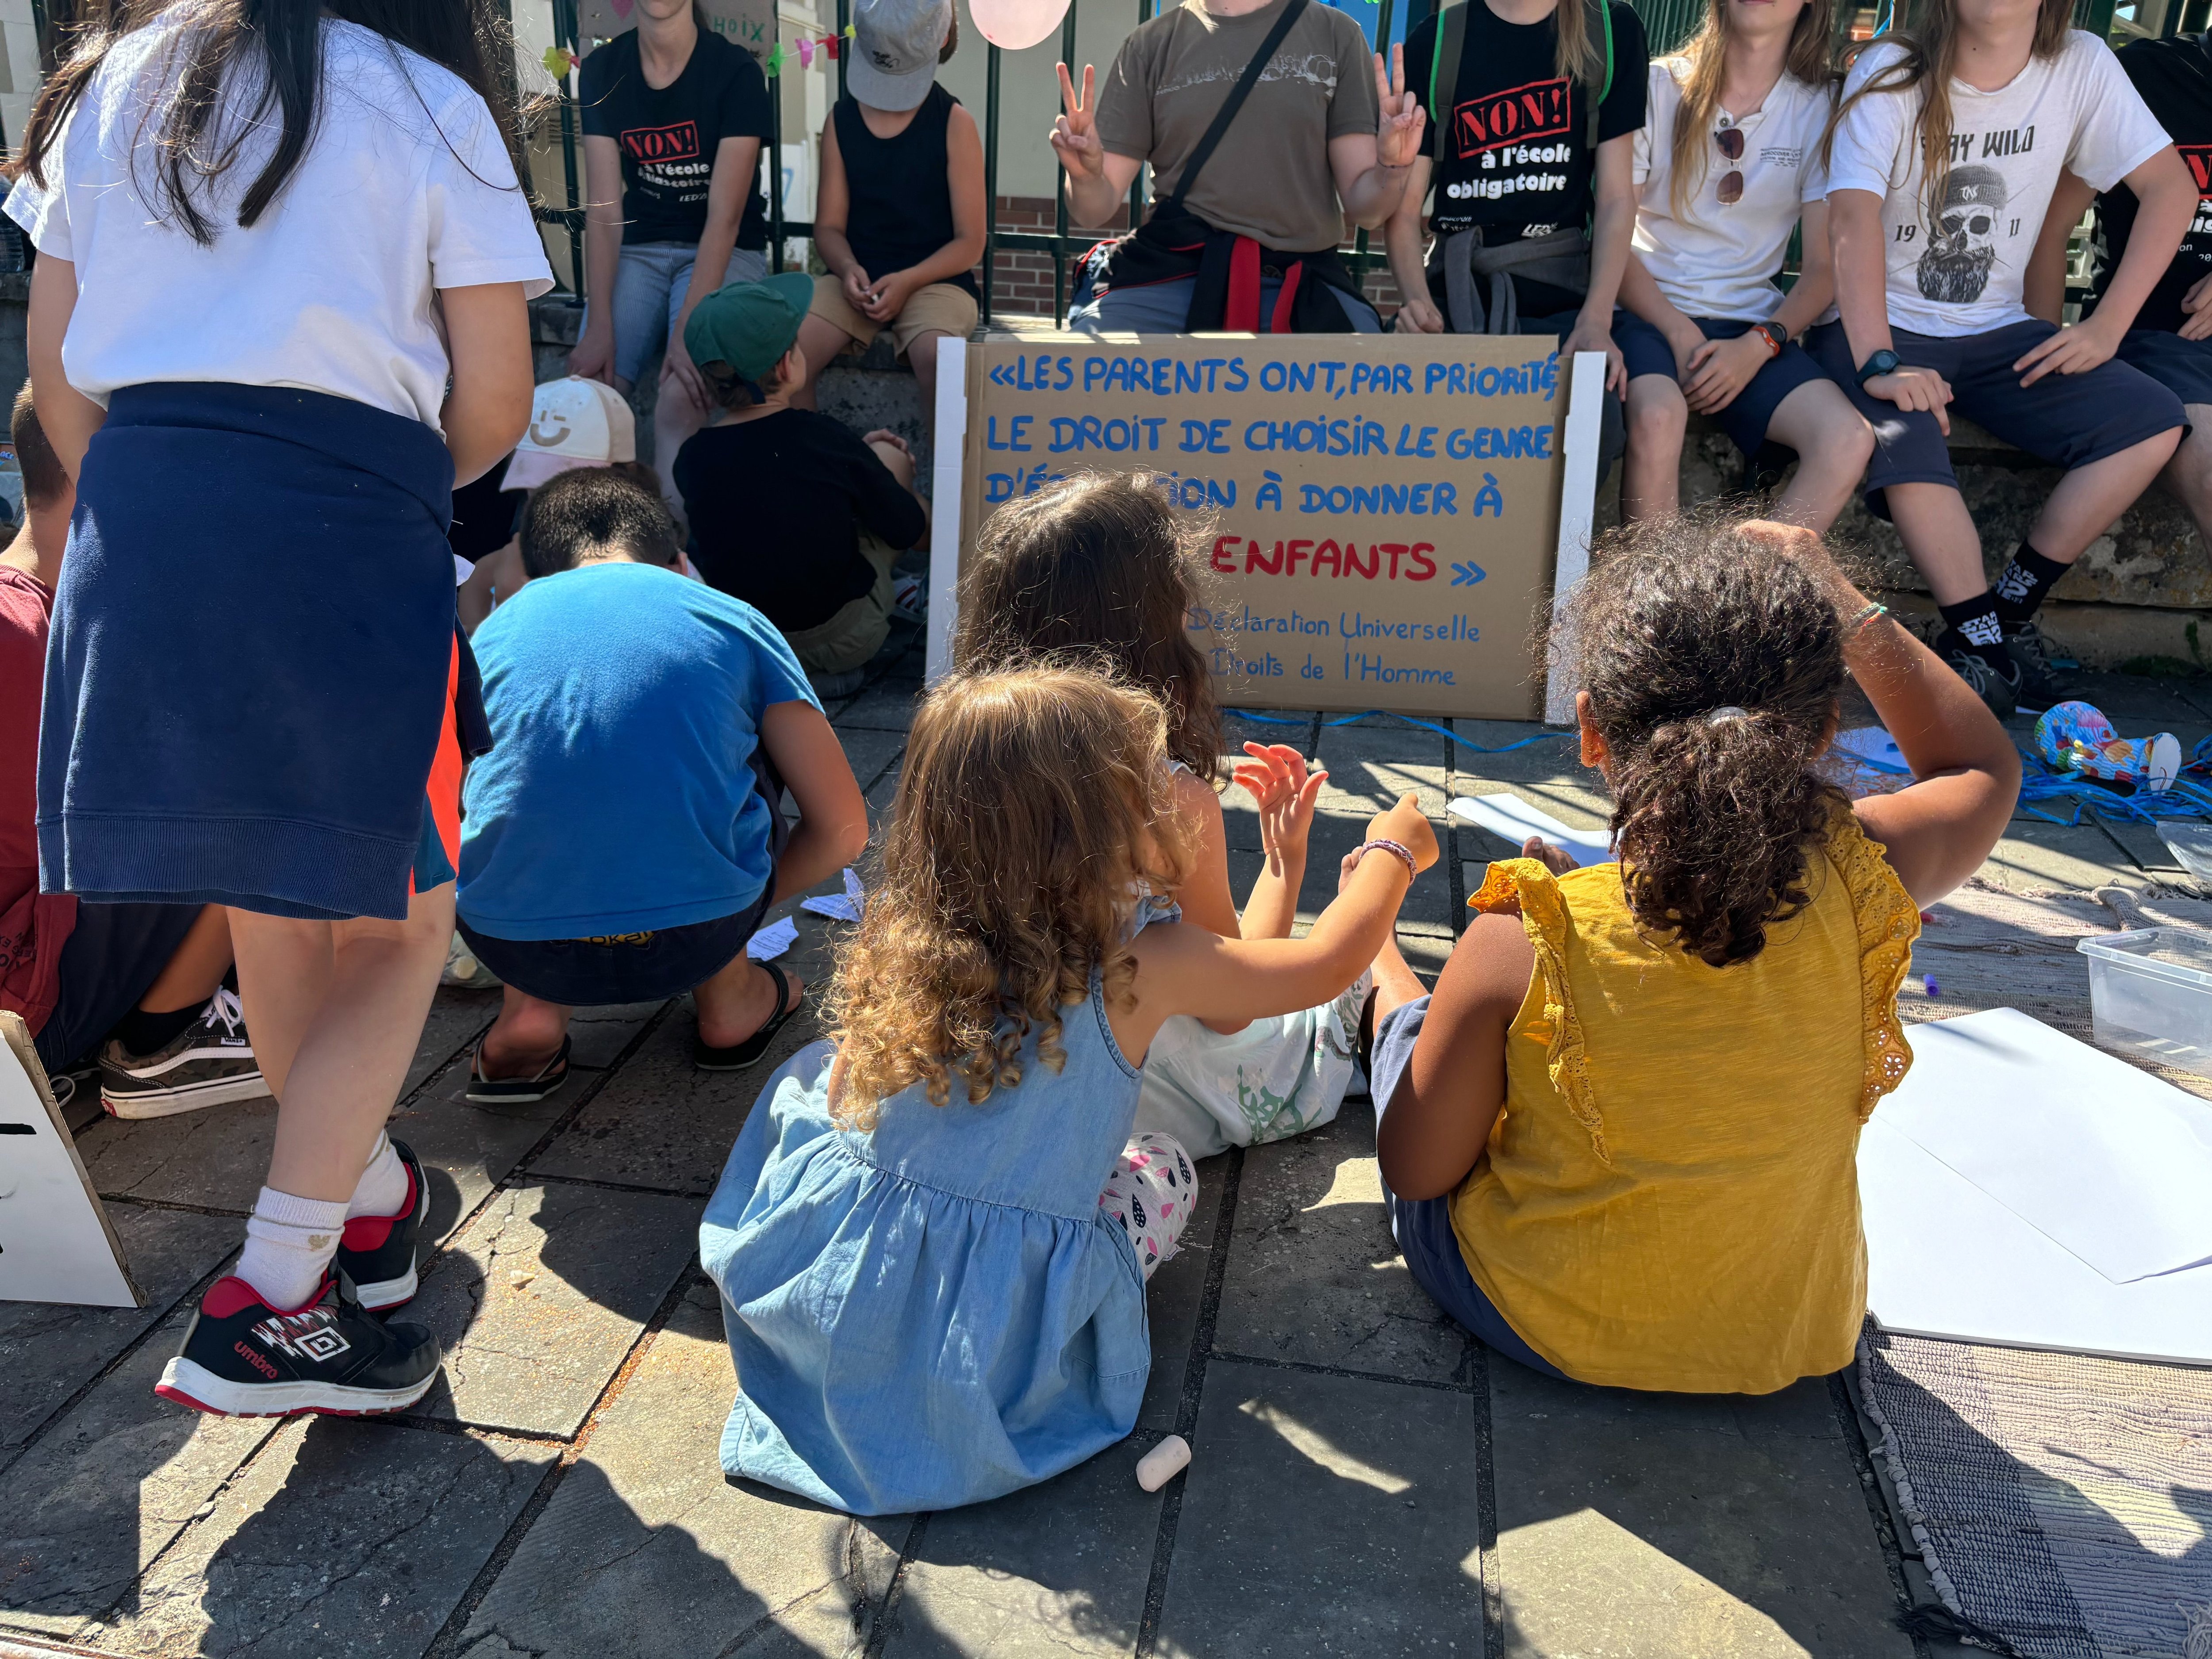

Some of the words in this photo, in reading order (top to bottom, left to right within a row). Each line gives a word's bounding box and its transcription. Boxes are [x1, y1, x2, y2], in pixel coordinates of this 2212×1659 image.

[1460, 88, 1561, 146] NON!
[626, 128, 693, 157] NON!
[1481, 150, 1496, 169] à
[1502, 143, 1571, 167] l'école
[1982, 125, 2035, 158] WILD
[655, 163, 710, 176] l'école
[1447, 172, 1567, 200] obligatoire
[1894, 225, 1916, 242] 19
[1084, 357, 1249, 395] PARENTS
[1350, 362, 1413, 395] PAR
[987, 415, 1034, 451] LE
[1178, 419, 1232, 454] DE
[1395, 423, 1439, 458] LE
[1445, 425, 1554, 460] GENRE
[1256, 470, 1283, 511] À
[1299, 482, 1458, 515] DONNER
[1473, 472, 1503, 518] À
[1210, 535, 1437, 581] ENFANTS
[1339, 611, 1480, 642] Universelle
[1209, 646, 1283, 676] Droits
[1301, 653, 1324, 680] de
[1344, 652, 1456, 685] l'Homme
[234, 1340, 278, 1379] umbro
